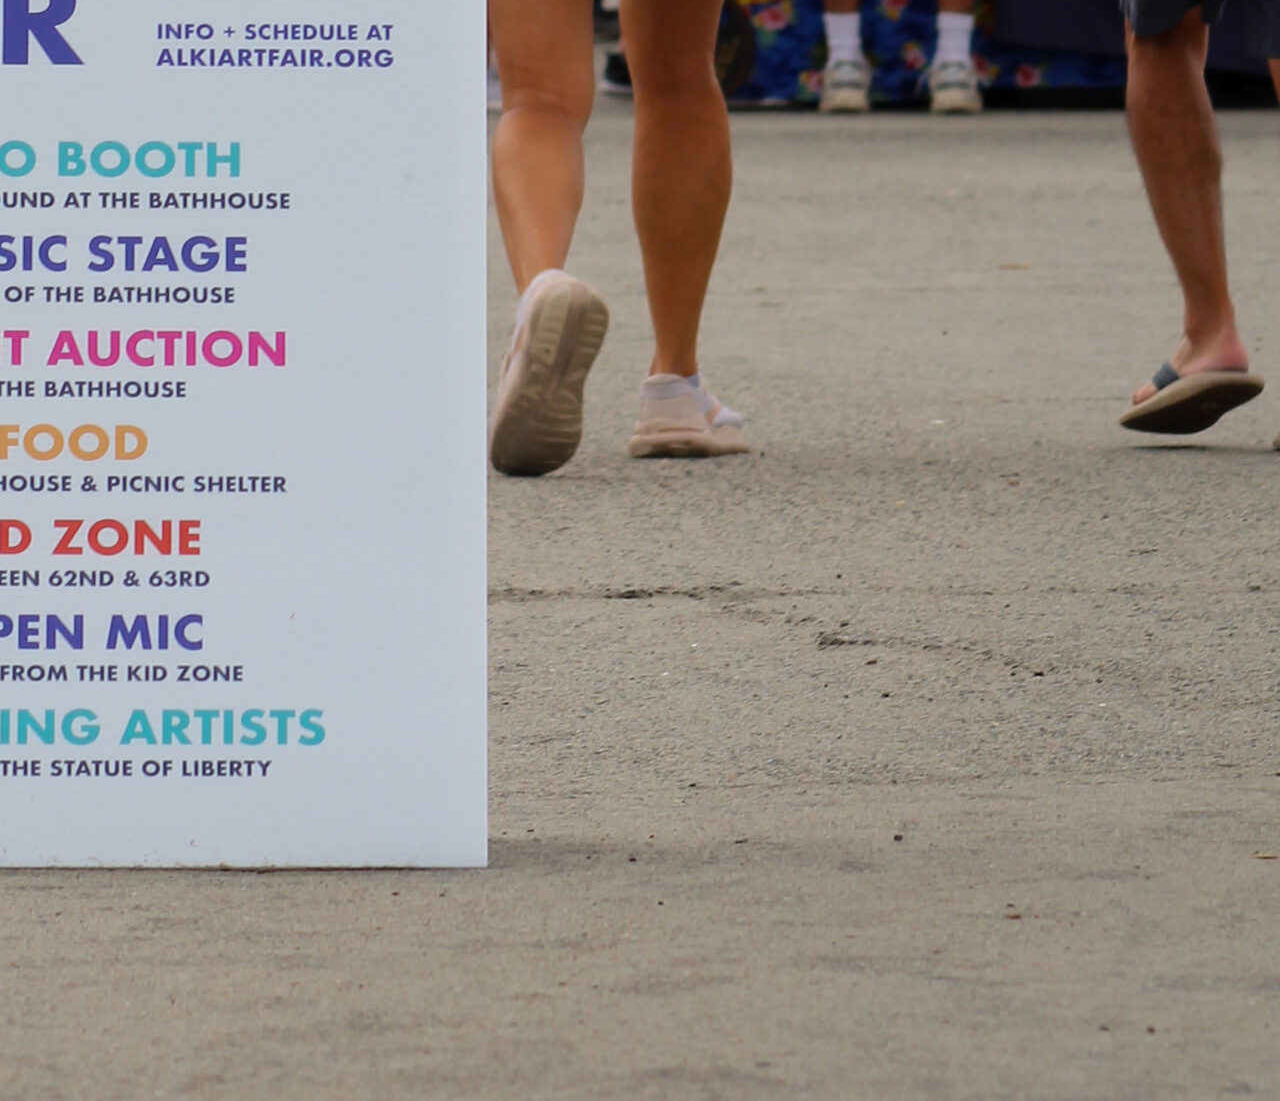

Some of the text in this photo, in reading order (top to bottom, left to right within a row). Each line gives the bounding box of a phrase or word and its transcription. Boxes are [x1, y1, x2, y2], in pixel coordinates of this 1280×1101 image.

[157, 23, 394, 41] INFO + SCHEDULE AT
[156, 48, 394, 68] ALKIARTFAIR.ORG
[57, 140, 241, 179] BOOTH
[63, 191, 92, 209] AT
[98, 191, 140, 209] THE
[149, 192, 291, 210] BATHHOUSE
[87, 234, 248, 273] STAGE
[4, 285, 36, 303] OF
[42, 286, 84, 303] THE
[93, 286, 235, 304] BATHHOUSE
[46, 329, 287, 368] AUCTION
[44, 380, 187, 399] BATHHOUSE
[80, 475, 98, 493] &
[107, 475, 185, 493] PICNIC
[193, 475, 287, 493] SHELTER
[51, 518, 201, 557] ZONE
[48, 569, 115, 587] 62ND
[122, 570, 140, 588] &
[148, 570, 211, 588] 63RD
[105, 613, 204, 651] MIC
[0, 664, 68, 682] FROM
[75, 664, 118, 682] THE
[127, 665, 168, 682] KID
[176, 664, 244, 682] ZONE
[119, 708, 326, 747] ARTISTS
[0, 759, 41, 777] THE
[50, 759, 133, 777] STATUE
[141, 759, 173, 777] OF
[181, 759, 272, 777] LIBERTY
